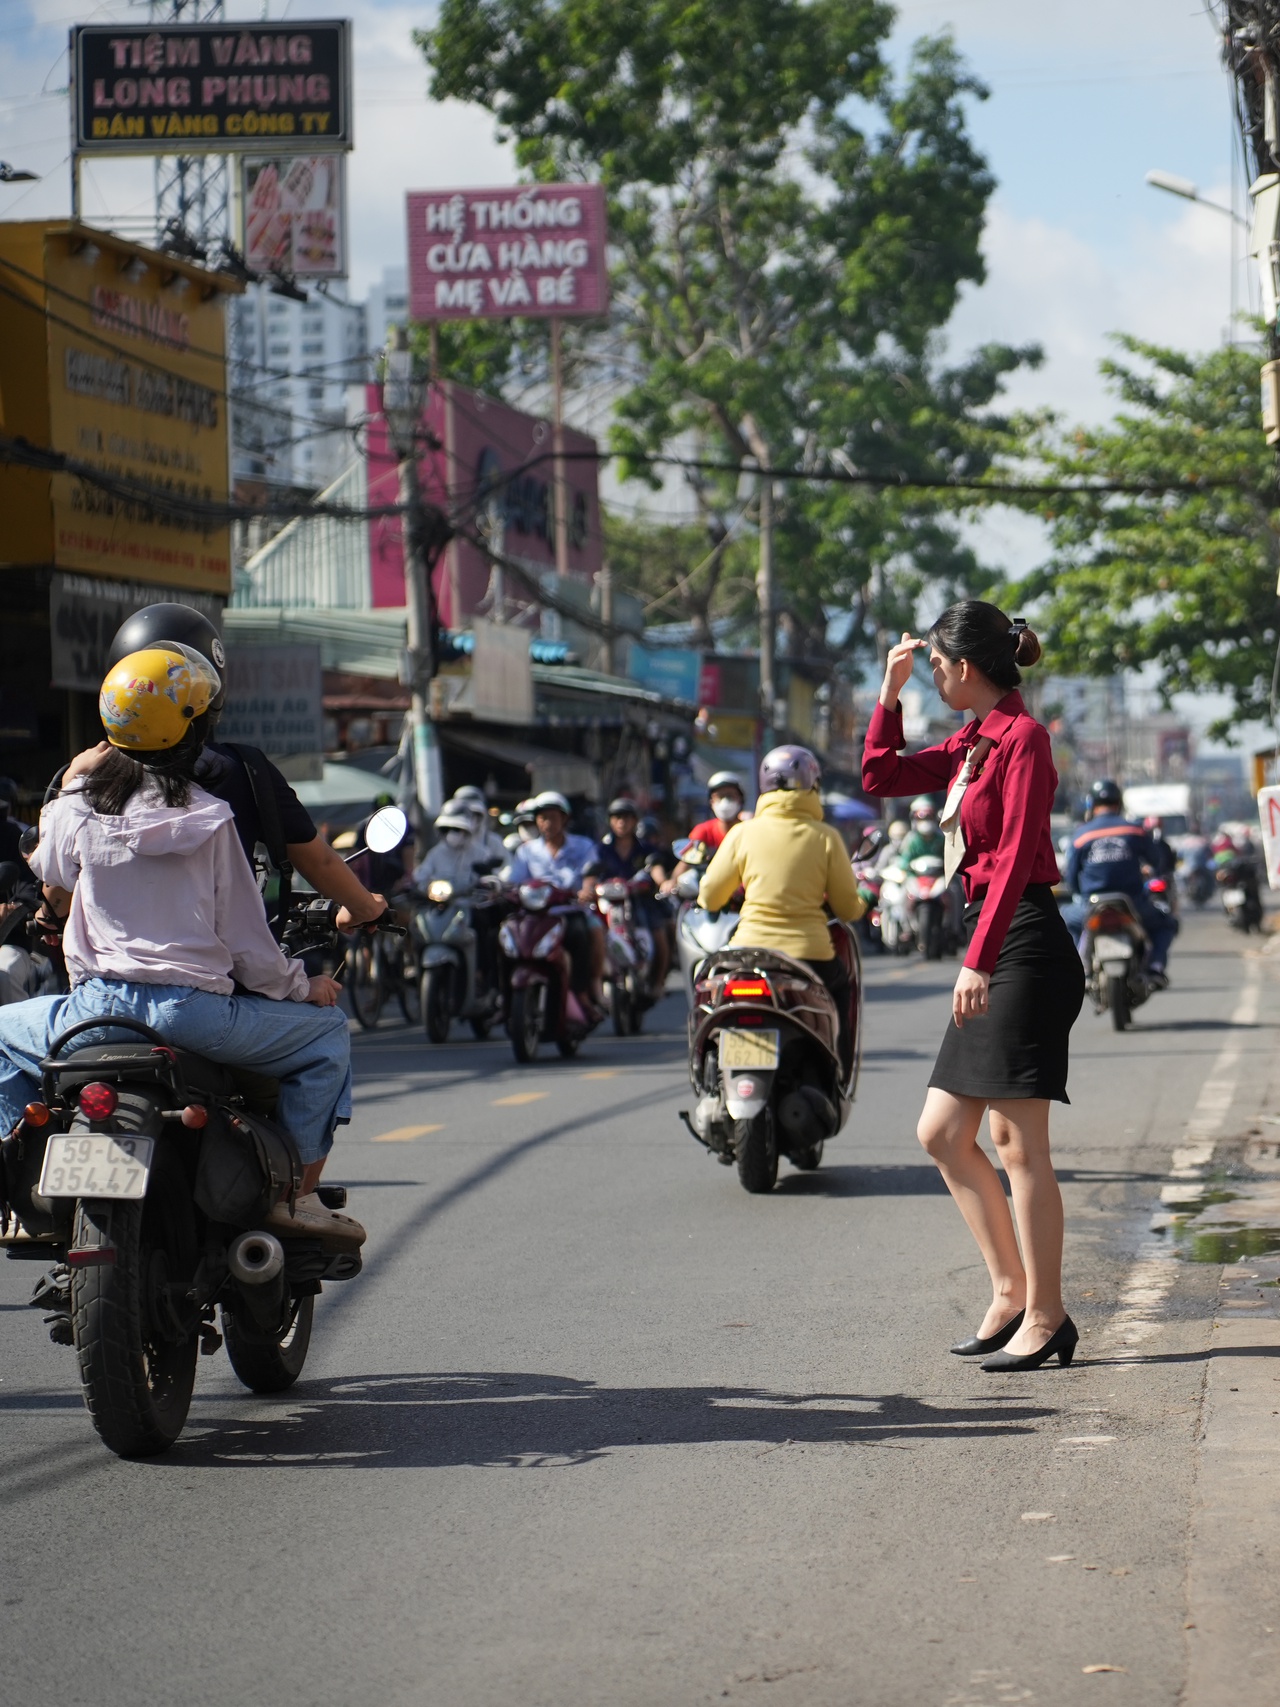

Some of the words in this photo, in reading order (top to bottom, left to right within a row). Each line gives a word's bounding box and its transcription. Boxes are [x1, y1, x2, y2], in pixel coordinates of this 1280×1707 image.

[110, 33, 200, 74] TIỆM
[210, 30, 313, 67] VÀNG
[92, 76, 192, 108] LONG
[201, 73, 331, 111] PHỤNG
[91, 112, 145, 138] BÁN
[151, 111, 219, 136] VÀNG
[225, 110, 295, 134] CÔNG
[299, 111, 332, 133] TY
[425, 194, 467, 237] HỆ
[469, 187, 583, 230] THỐNG
[497, 232, 589, 270] HÀNG
[434, 277, 484, 315] MẸ
[487, 268, 532, 306] VÀ
[536, 267, 577, 305] BÉ
[62, 1139, 137, 1165] 59-C3
[49, 1166, 140, 1194] 354.47
